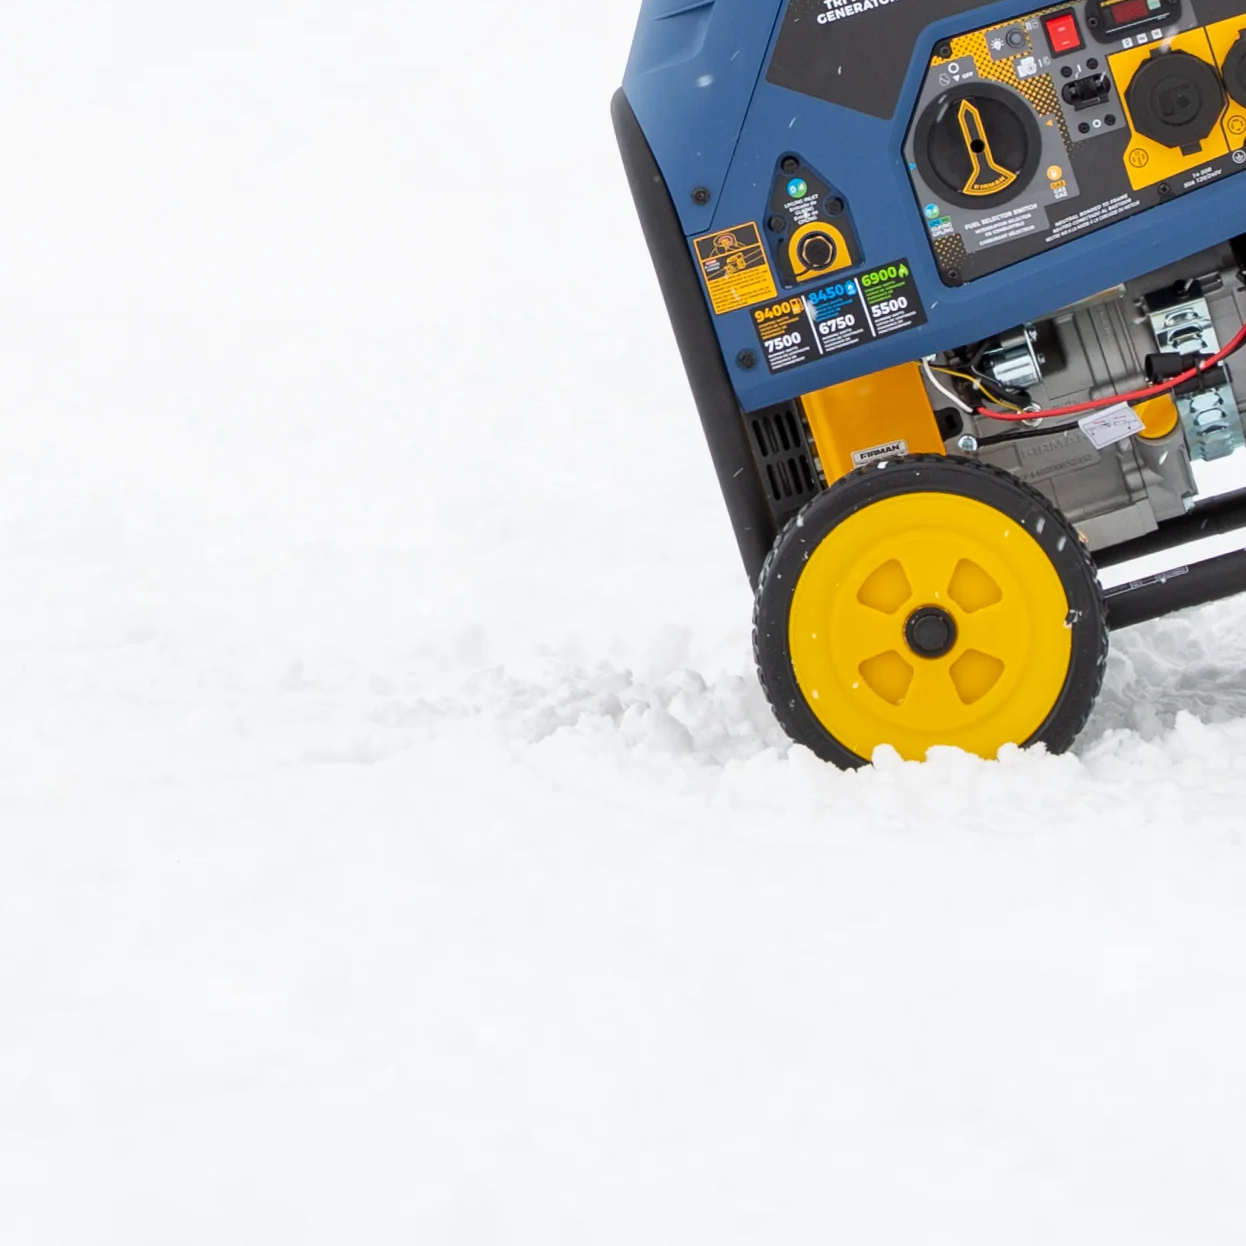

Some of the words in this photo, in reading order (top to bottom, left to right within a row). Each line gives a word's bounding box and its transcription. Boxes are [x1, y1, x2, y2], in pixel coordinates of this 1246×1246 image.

[965, 222, 980, 230] FUEL
[861, 266, 898, 287] 6900
[808, 286, 844, 305] 8450
[754, 301, 791, 323] 9400
[871, 297, 908, 318] 5500
[818, 314, 855, 335] 6750
[764, 331, 801, 353] 7500
[860, 444, 900, 460] FIRMAN
